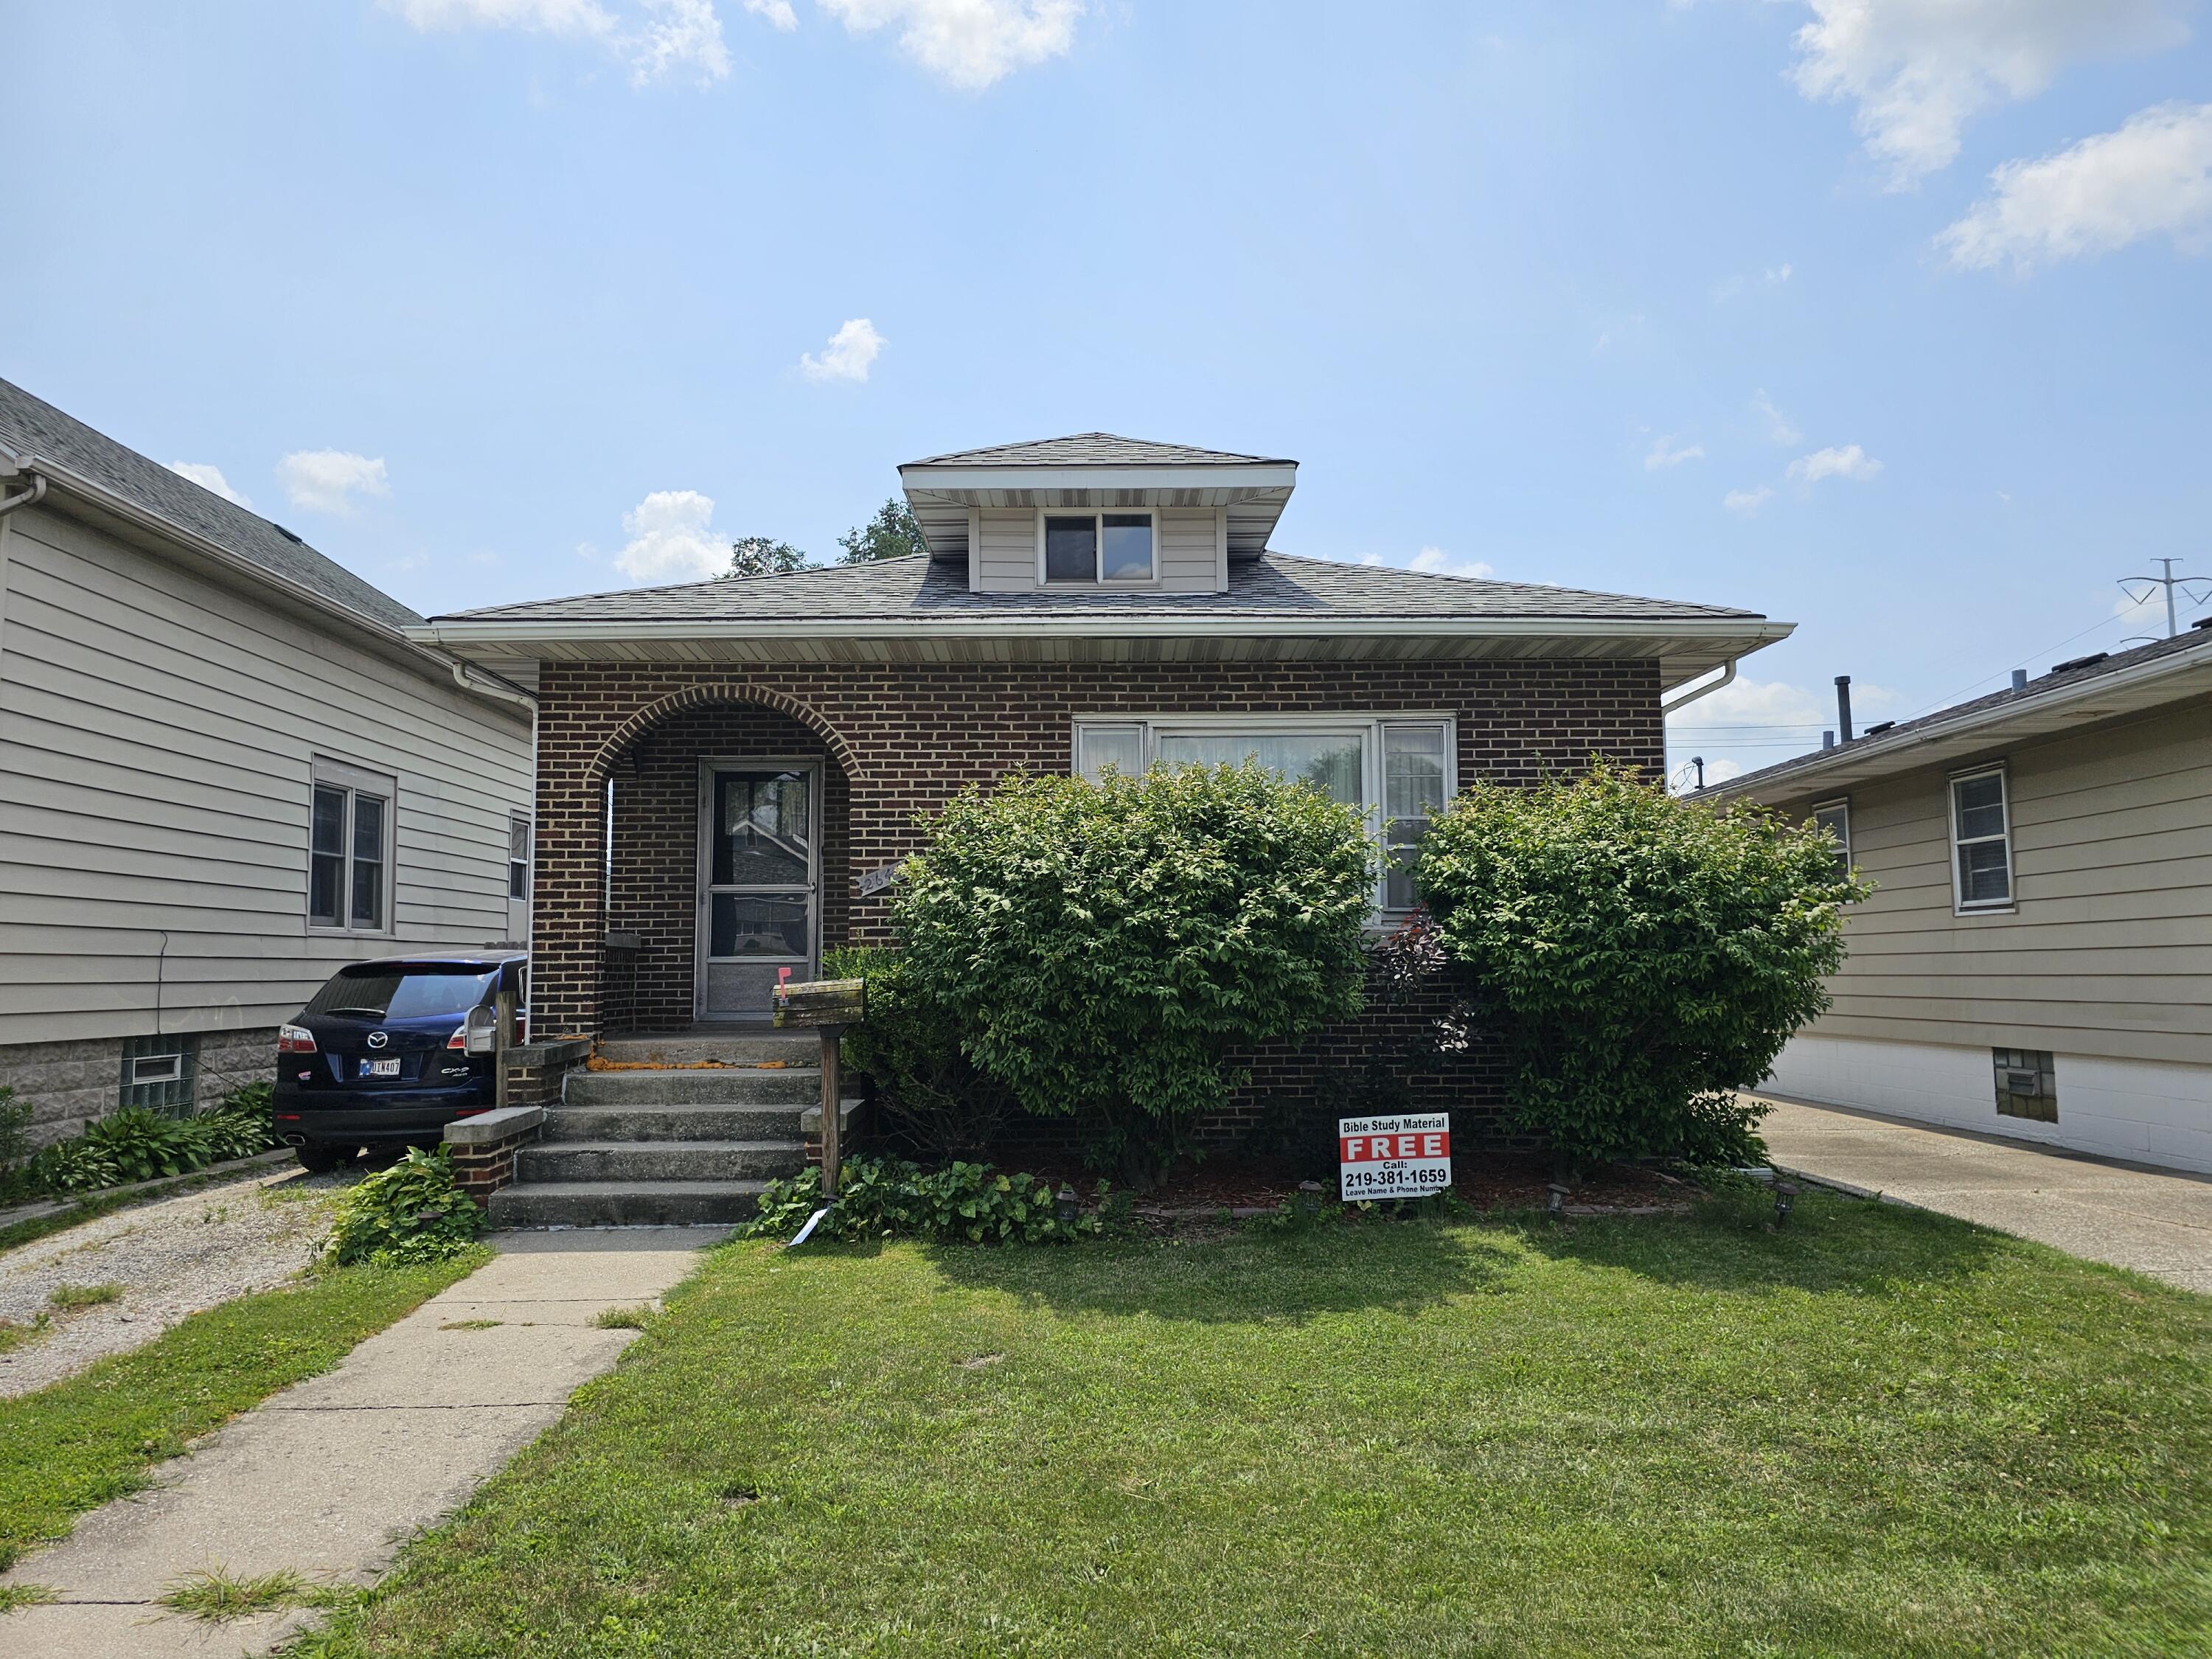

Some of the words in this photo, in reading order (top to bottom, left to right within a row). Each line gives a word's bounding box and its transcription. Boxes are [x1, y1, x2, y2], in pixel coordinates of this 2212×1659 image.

[864, 864, 900, 891] 264
[1343, 1121, 1368, 1133] Bible
[1371, 1119, 1400, 1133] Study
[1403, 1117, 1444, 1129] Material
[1347, 1135, 1442, 1161] FREE
[1383, 1161, 1408, 1169] Call:
[1346, 1168, 1447, 1187] 219-381-1659
[1346, 1188, 1366, 1196] Leave
[1419, 1184, 1441, 1192] Numb
